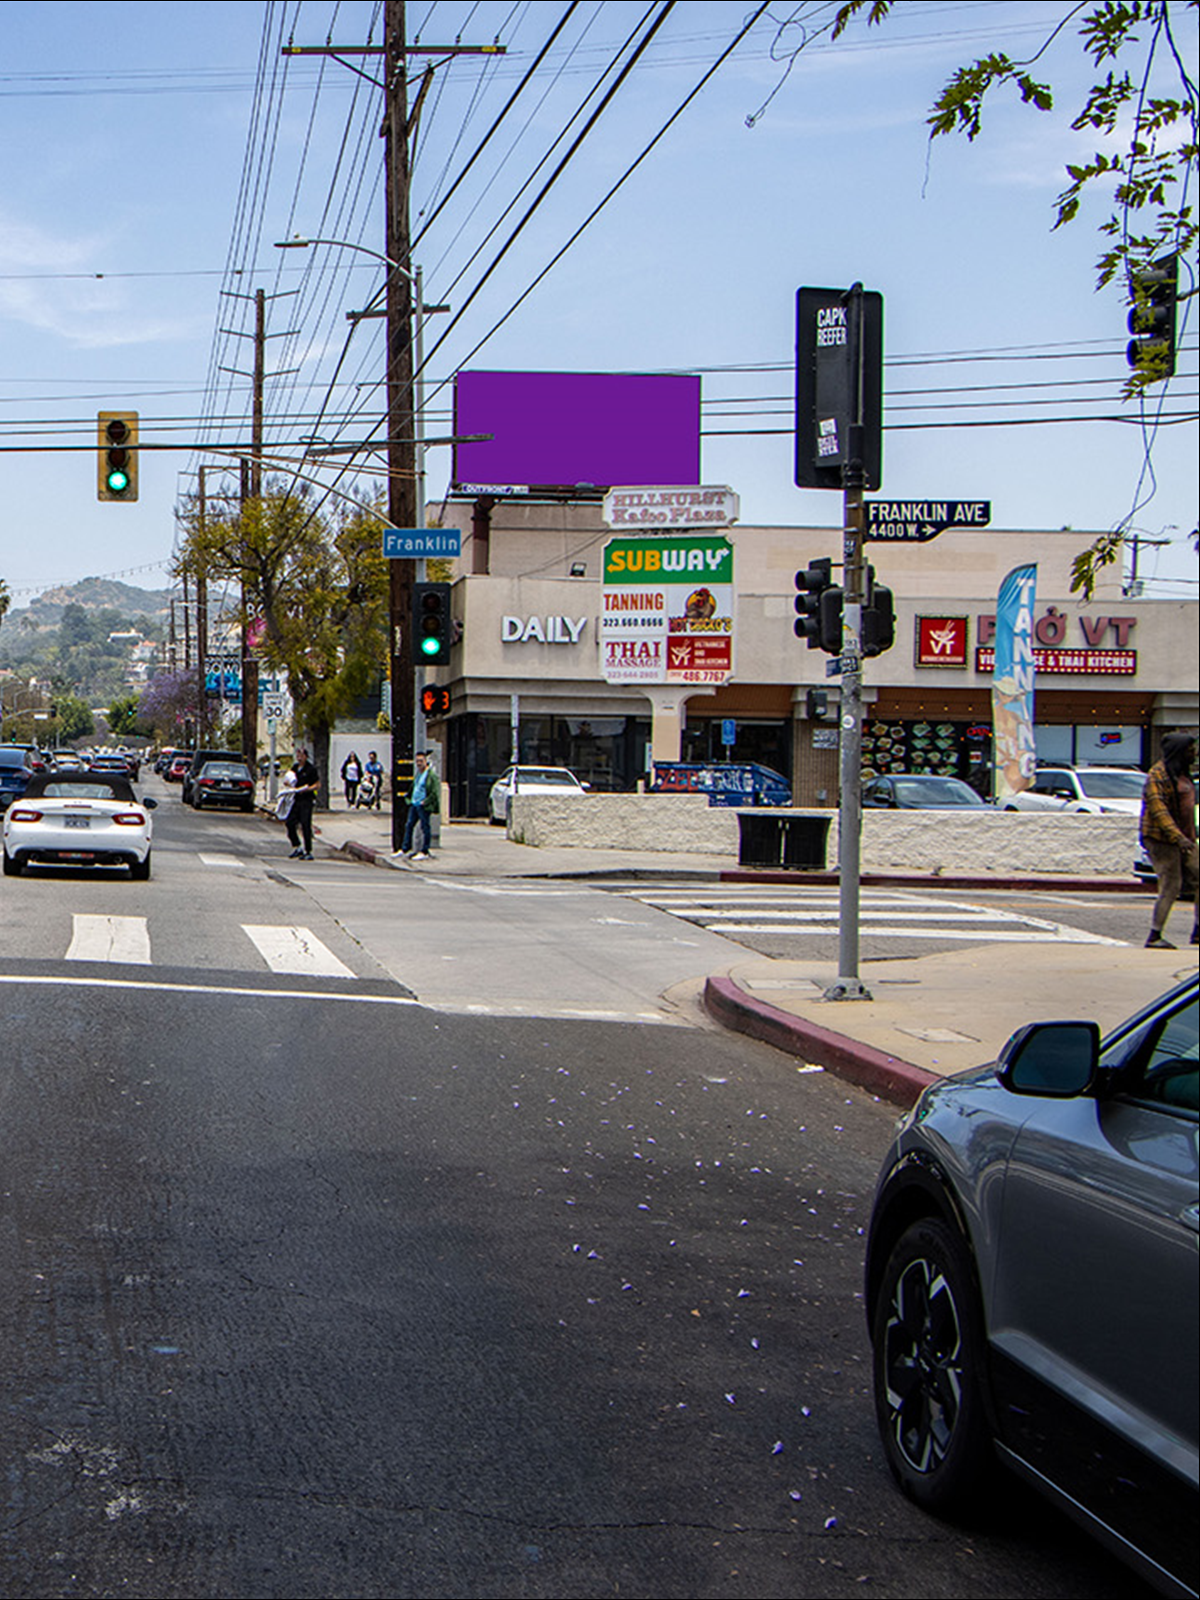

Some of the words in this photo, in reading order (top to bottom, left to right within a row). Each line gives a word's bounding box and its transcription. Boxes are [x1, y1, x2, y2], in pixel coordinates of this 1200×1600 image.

[613, 491, 727, 507] HILLHURST
[669, 506, 727, 522] Plaza
[868, 502, 948, 521] FRANKLIN
[953, 502, 988, 521] AVE.
[868, 523, 905, 537] 4400
[386, 535, 458, 551] Franklin
[606, 548, 730, 573] SUBWAY
[603, 592, 664, 611] TANNING
[502, 616, 587, 643] DAILY
[978, 606, 1067, 646] PỞ
[1079, 616, 1138, 646] VT
[605, 641, 661, 658] THAI
[605, 658, 661, 668] MASSAGE
[1058, 655, 1085, 668] THAI
[1087, 656, 1134, 669] KITCHEN
[441, 691, 450, 710] 3
[265, 706, 282, 717] 30
